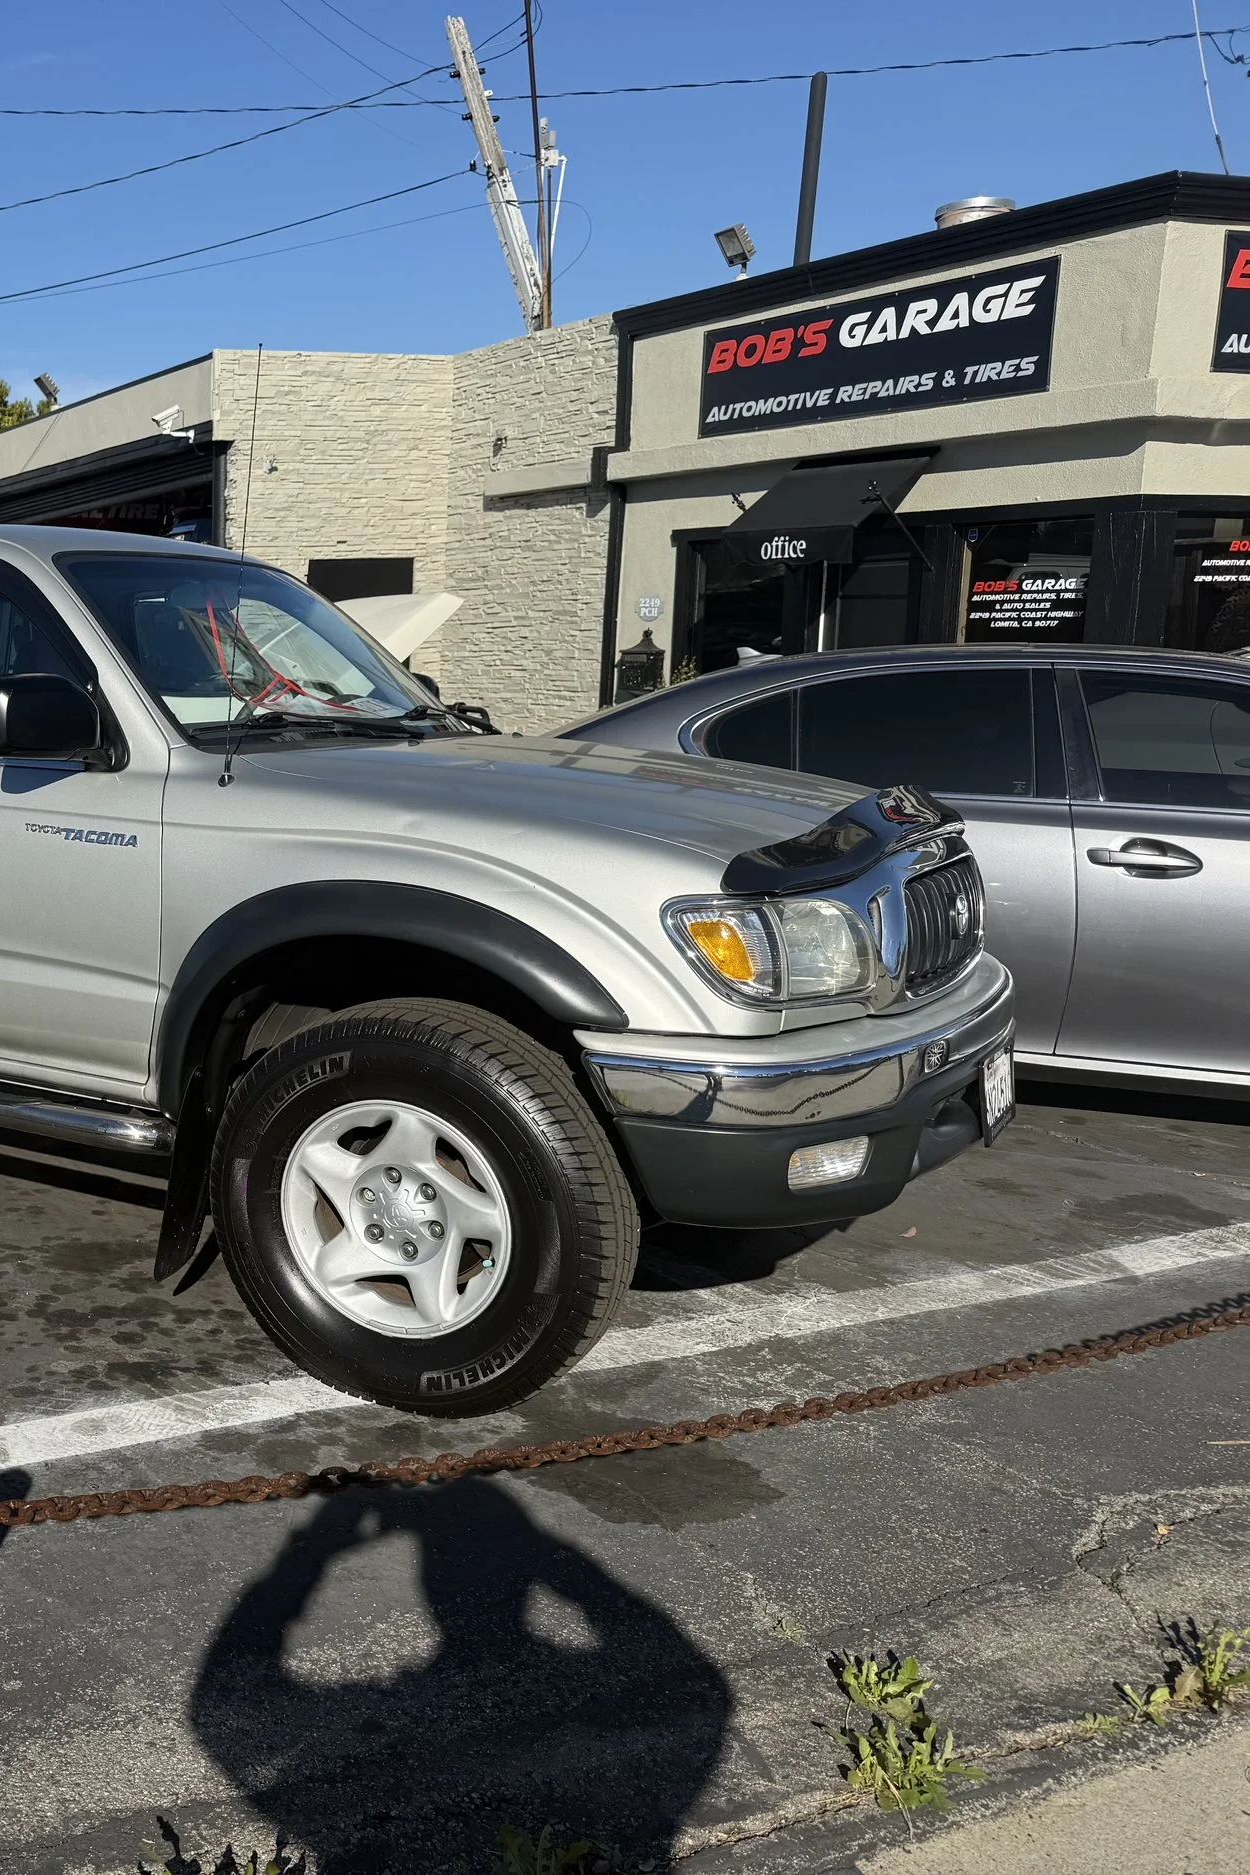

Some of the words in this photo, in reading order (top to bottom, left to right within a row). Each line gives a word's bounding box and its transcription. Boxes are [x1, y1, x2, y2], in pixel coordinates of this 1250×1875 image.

[707, 319, 834, 374] BOB'S
[839, 275, 1046, 348] GARAGE
[705, 387, 834, 424] AUTOMOTIVE
[836, 372, 937, 404] REPAIRS
[941, 370, 956, 388] &
[962, 355, 1039, 385] TIRES
[760, 536, 807, 560] office
[971, 593, 1020, 601] AUTOMOTIVE
[972, 580, 1019, 593] BOB'S
[1021, 578, 1088, 591] GARAGE
[639, 598, 661, 607] 2249
[640, 607, 658, 617] PCH
[25, 823, 62, 835] TOYOTA
[61, 827, 138, 848] TACOMA
[426, 1326, 533, 1392] MICHELIN
